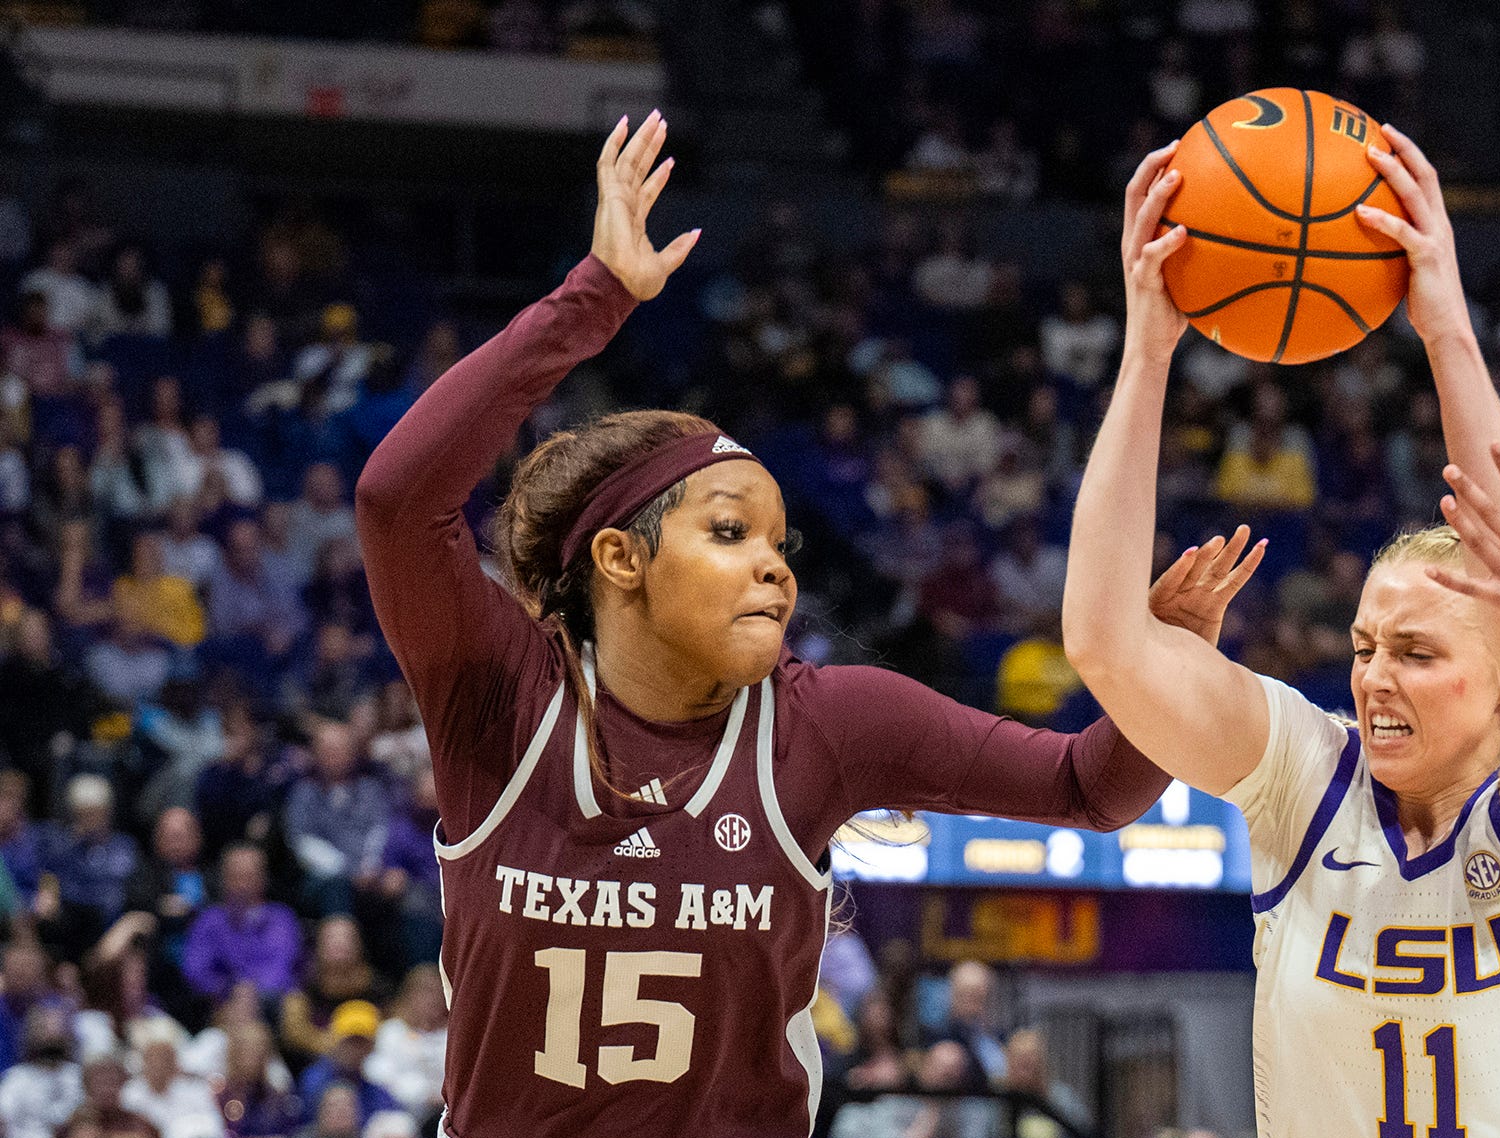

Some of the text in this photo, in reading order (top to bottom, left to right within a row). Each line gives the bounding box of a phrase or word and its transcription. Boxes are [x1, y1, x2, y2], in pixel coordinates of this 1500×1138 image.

[719, 816, 746, 850] SEC
[613, 845, 661, 858] adidas
[1466, 853, 1500, 889] SEC
[496, 865, 774, 930] TEXAS A&M
[534, 947, 703, 1090] 15
